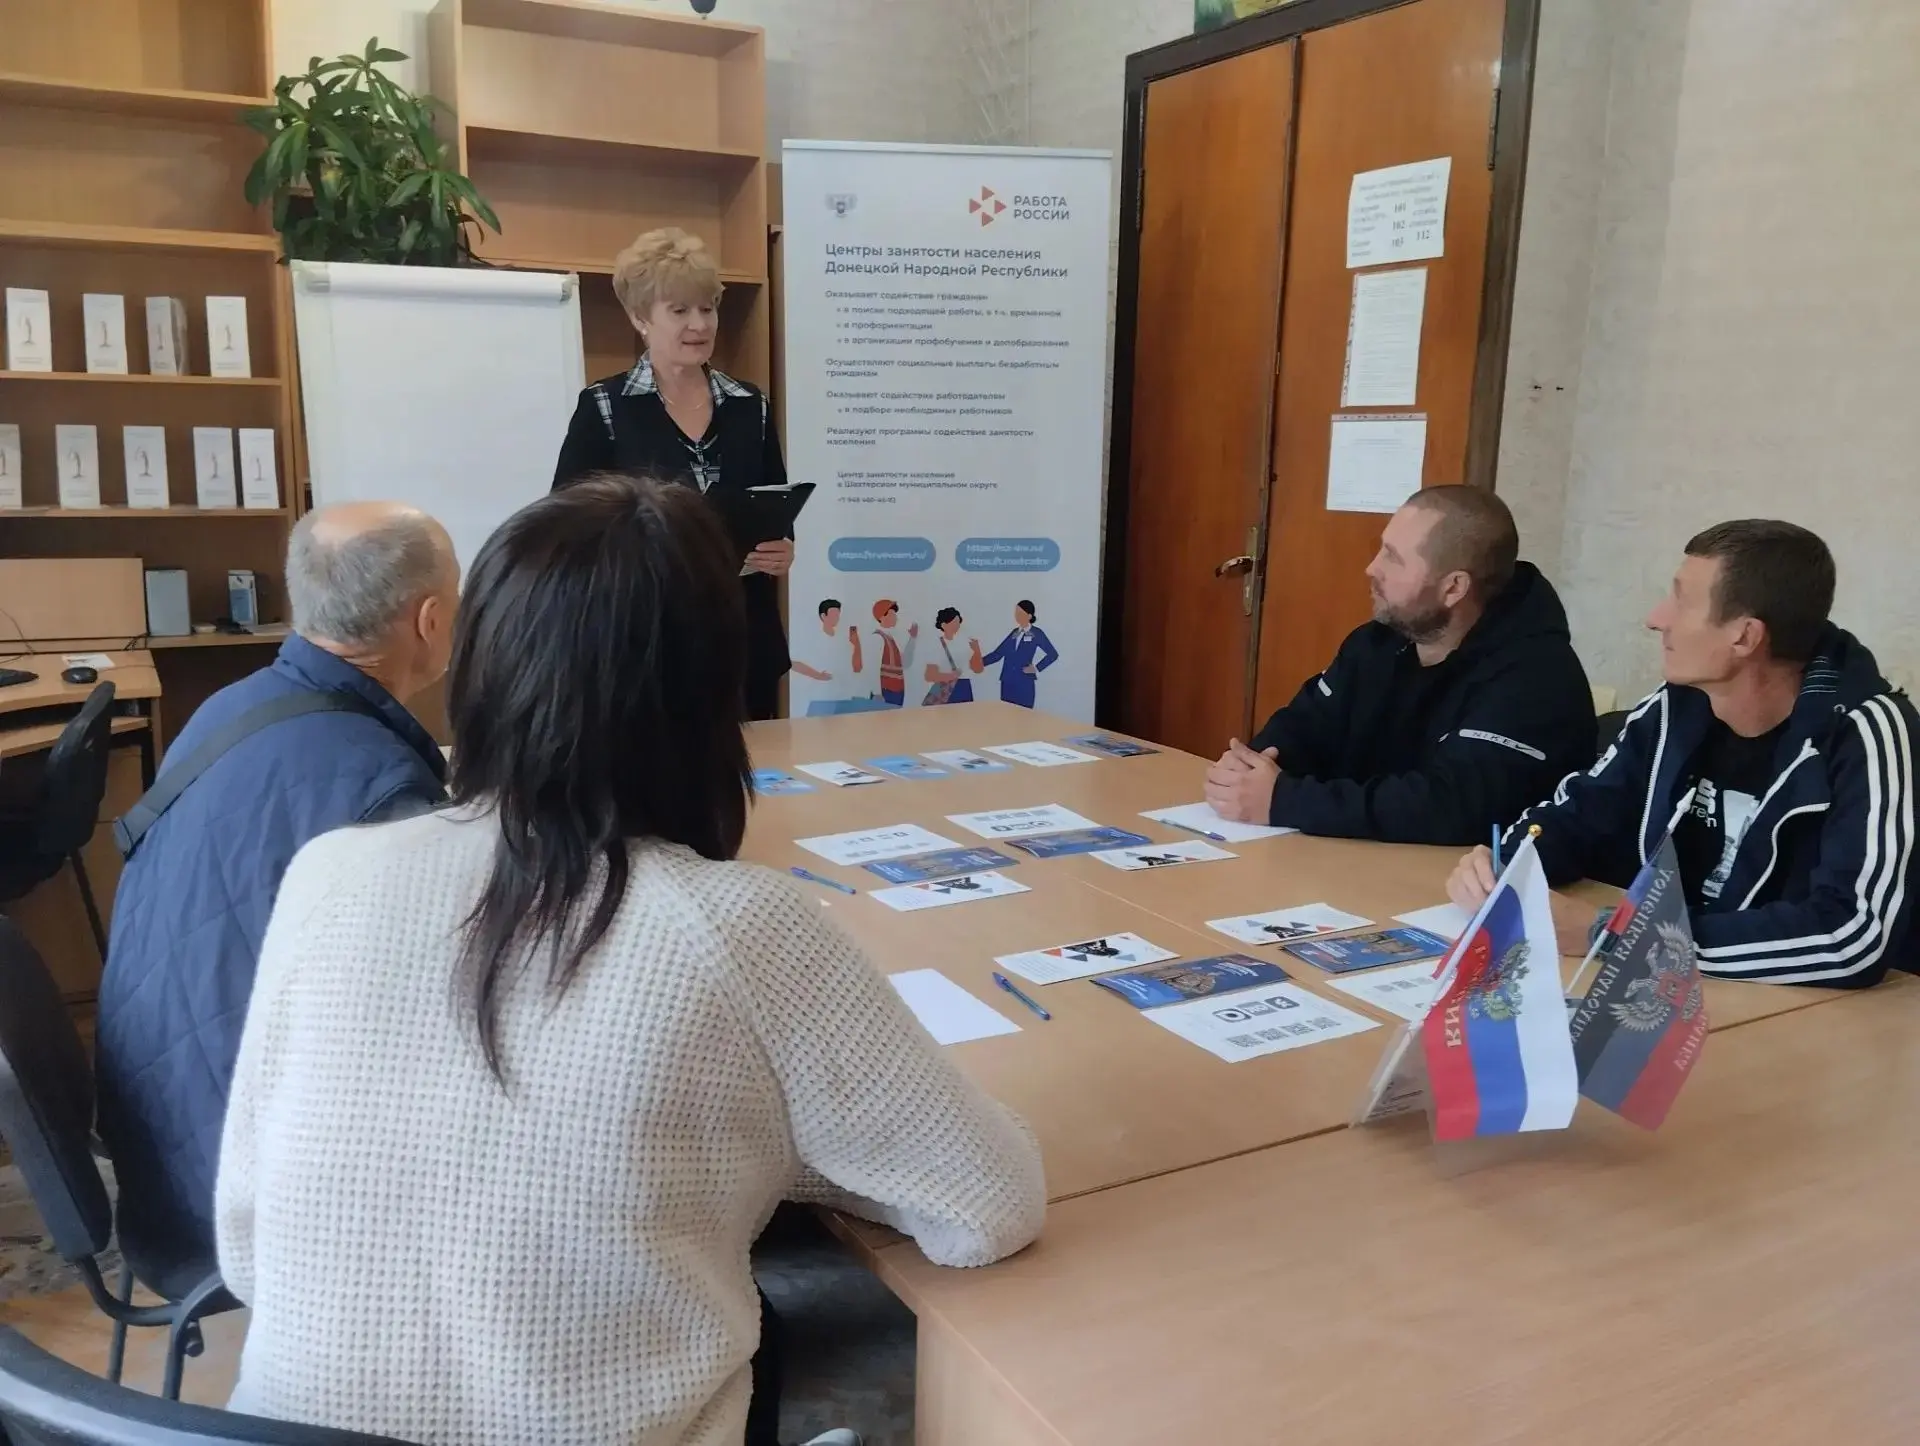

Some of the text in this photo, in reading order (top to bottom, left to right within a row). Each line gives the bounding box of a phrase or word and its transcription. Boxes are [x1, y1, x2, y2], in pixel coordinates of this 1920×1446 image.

[1013, 195, 1067, 207] РАБОТА
[1013, 209, 1070, 220] РОССИИ
[825, 243, 1042, 260] Центры занятости населения
[825, 261, 1068, 279] Донецкой Народной Республики
[888, 307, 946, 315] подходящей
[852, 321, 933, 330] профориентации
[915, 338, 983, 347] профобучения
[825, 358, 895, 367] Осуществляют
[998, 360, 1060, 369] безработным
[825, 370, 879, 378] гражданам
[880, 391, 934, 400] содействие
[936, 392, 1006, 401] работодателям
[852, 406, 891, 414] подборе
[894, 406, 957, 415] необходимых
[959, 408, 1013, 416] работников
[826, 427, 877, 436] Реализуют
[879, 428, 932, 437] программы
[826, 438, 876, 446] населения
[837, 471, 864, 479] Центр
[899, 481, 967, 489] муниципальном
[969, 482, 998, 490] округе
